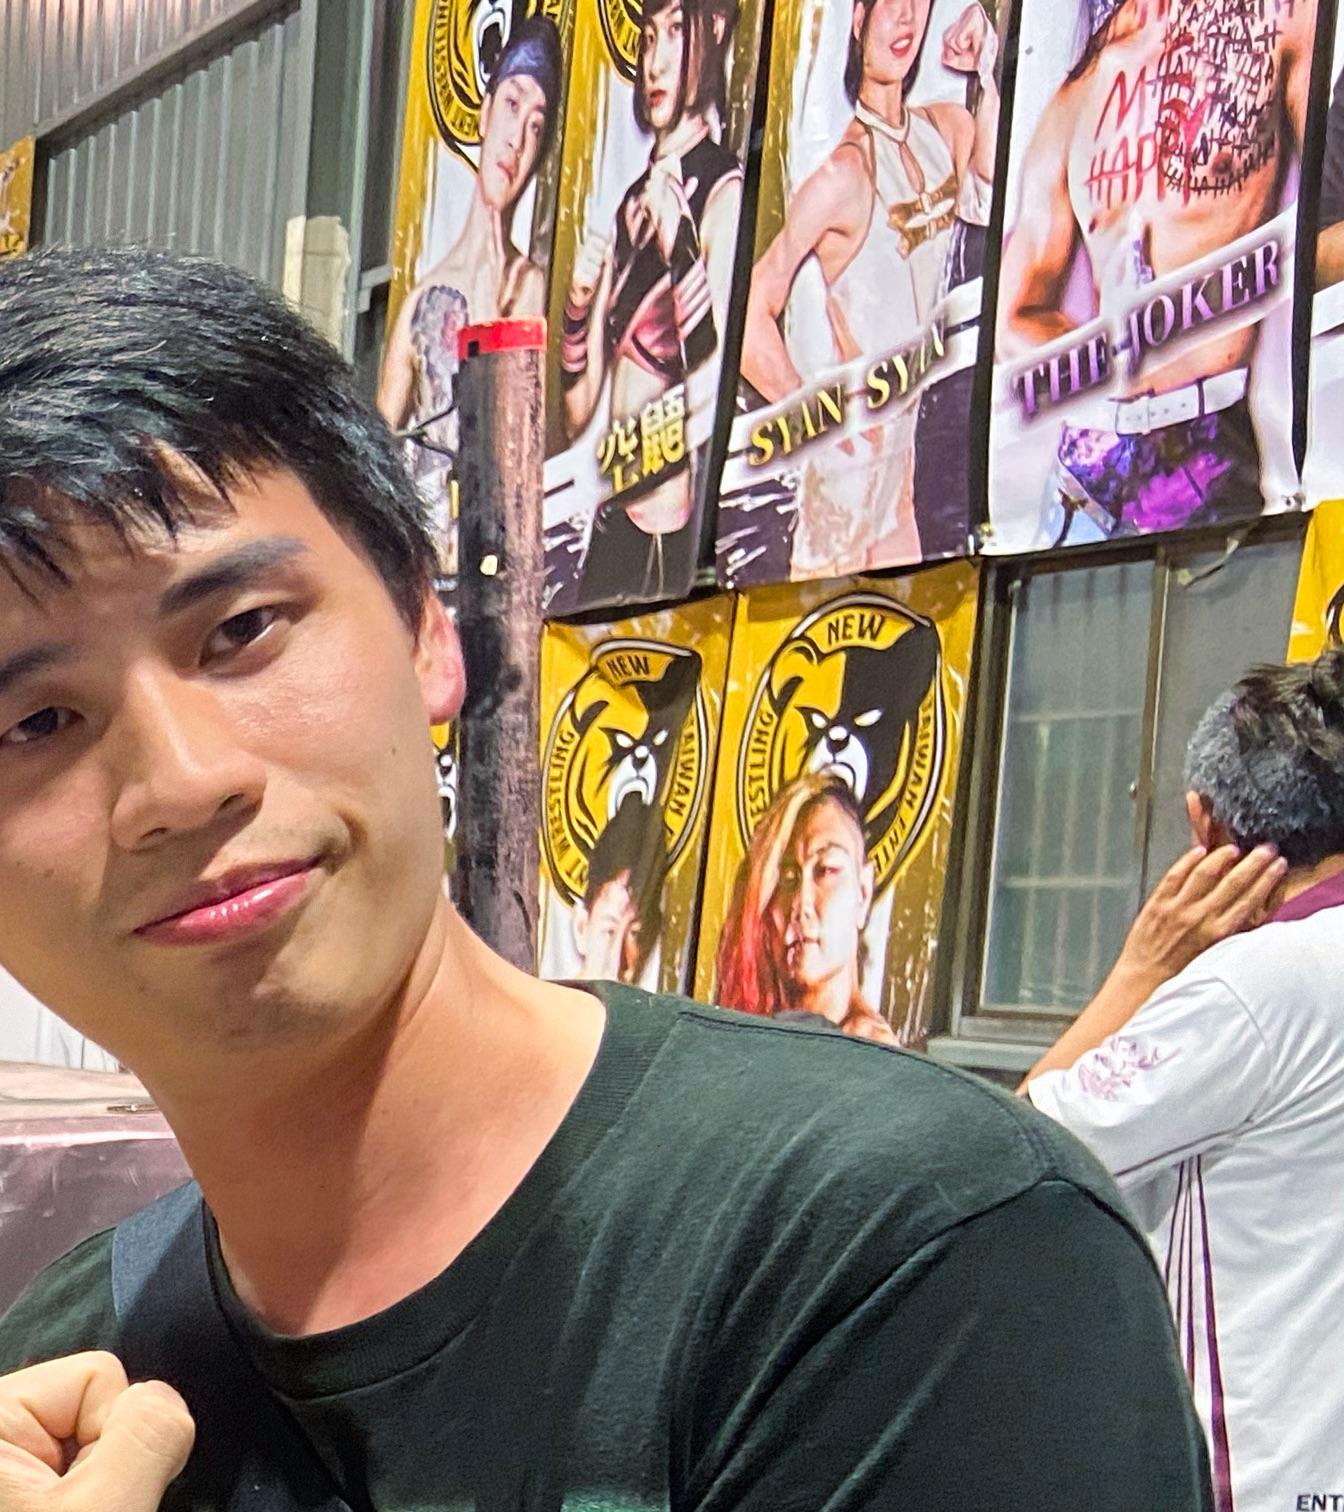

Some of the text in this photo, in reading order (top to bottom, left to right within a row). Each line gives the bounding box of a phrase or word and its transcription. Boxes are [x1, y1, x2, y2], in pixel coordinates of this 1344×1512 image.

[1014, 240, 1280, 418] THE JOKER
[747, 383, 843, 467] SYAN
[827, 613, 886, 646] NEW
[606, 654, 651, 682] NEW
[750, 711, 774, 819] ESTLING
[1295, 1493, 1344, 1512] ENT
